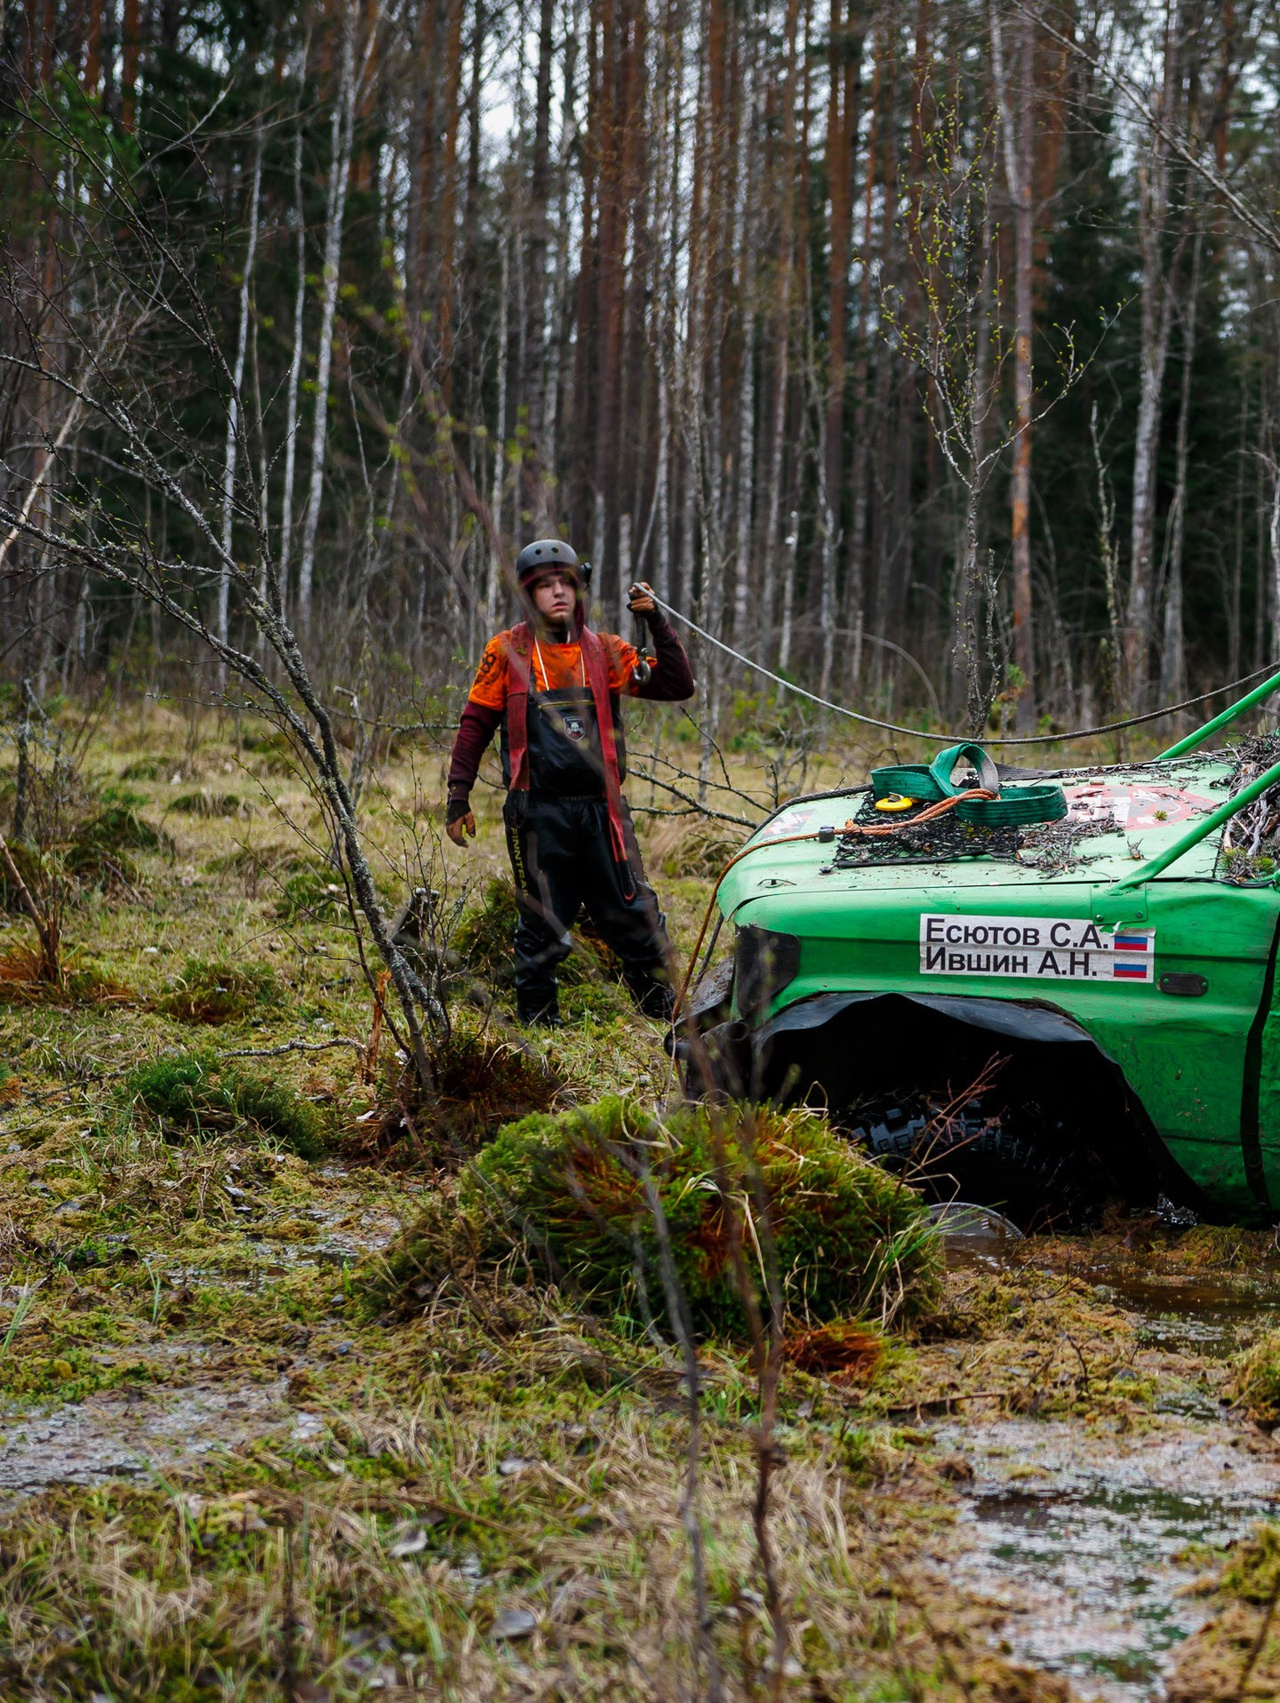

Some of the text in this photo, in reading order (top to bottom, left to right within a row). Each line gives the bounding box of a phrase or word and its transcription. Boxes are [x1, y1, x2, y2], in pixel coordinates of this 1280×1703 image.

[510, 827, 528, 900] FINNTRAIL
[926, 918, 1109, 949] Есютов С.А.
[925, 946, 1097, 976] Ившин А.Н.
